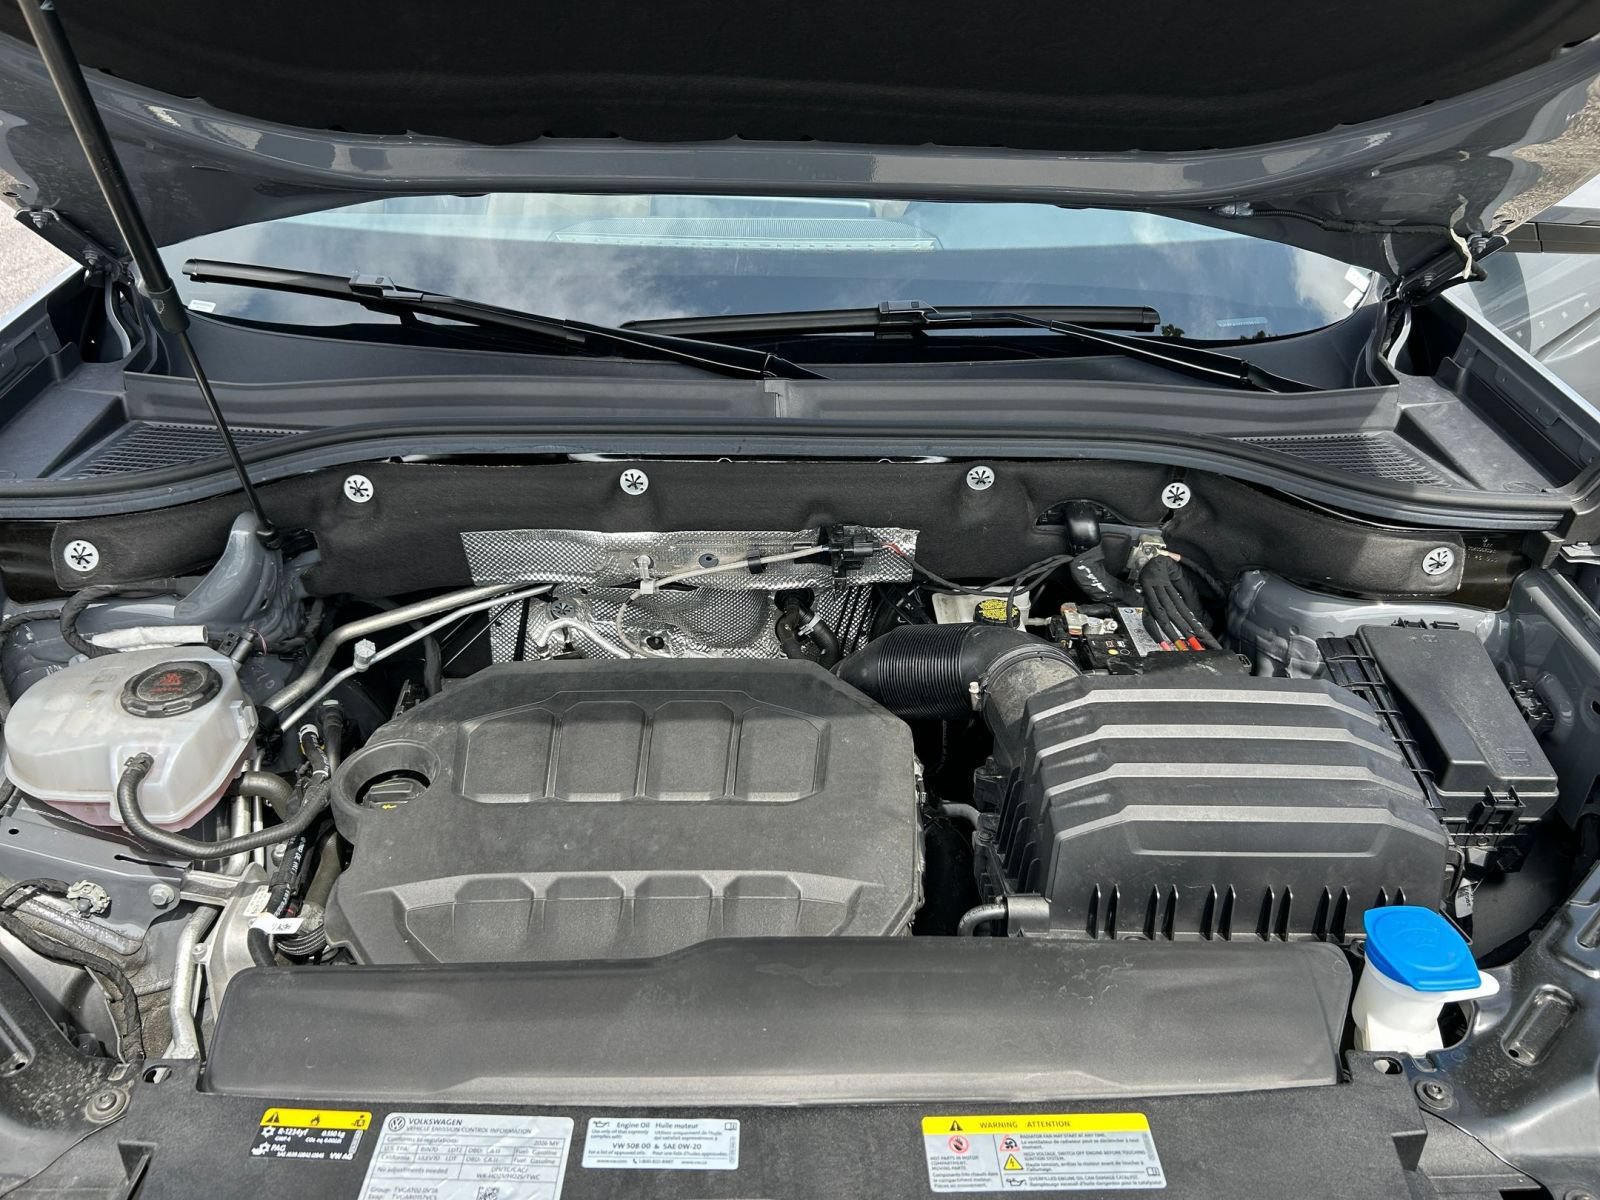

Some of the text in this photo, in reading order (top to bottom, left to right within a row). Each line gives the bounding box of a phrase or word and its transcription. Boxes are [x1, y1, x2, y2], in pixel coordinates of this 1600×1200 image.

[409, 1117, 463, 1126] VOLKSWAGEN
[980, 1120, 1070, 1129] WARNING ATTENTION
[617, 1122, 638, 1130] Engine
[278, 1128, 309, 1138] R-1234yf
[271, 1144, 286, 1152] PAG
[330, 1152, 342, 1160] VW
